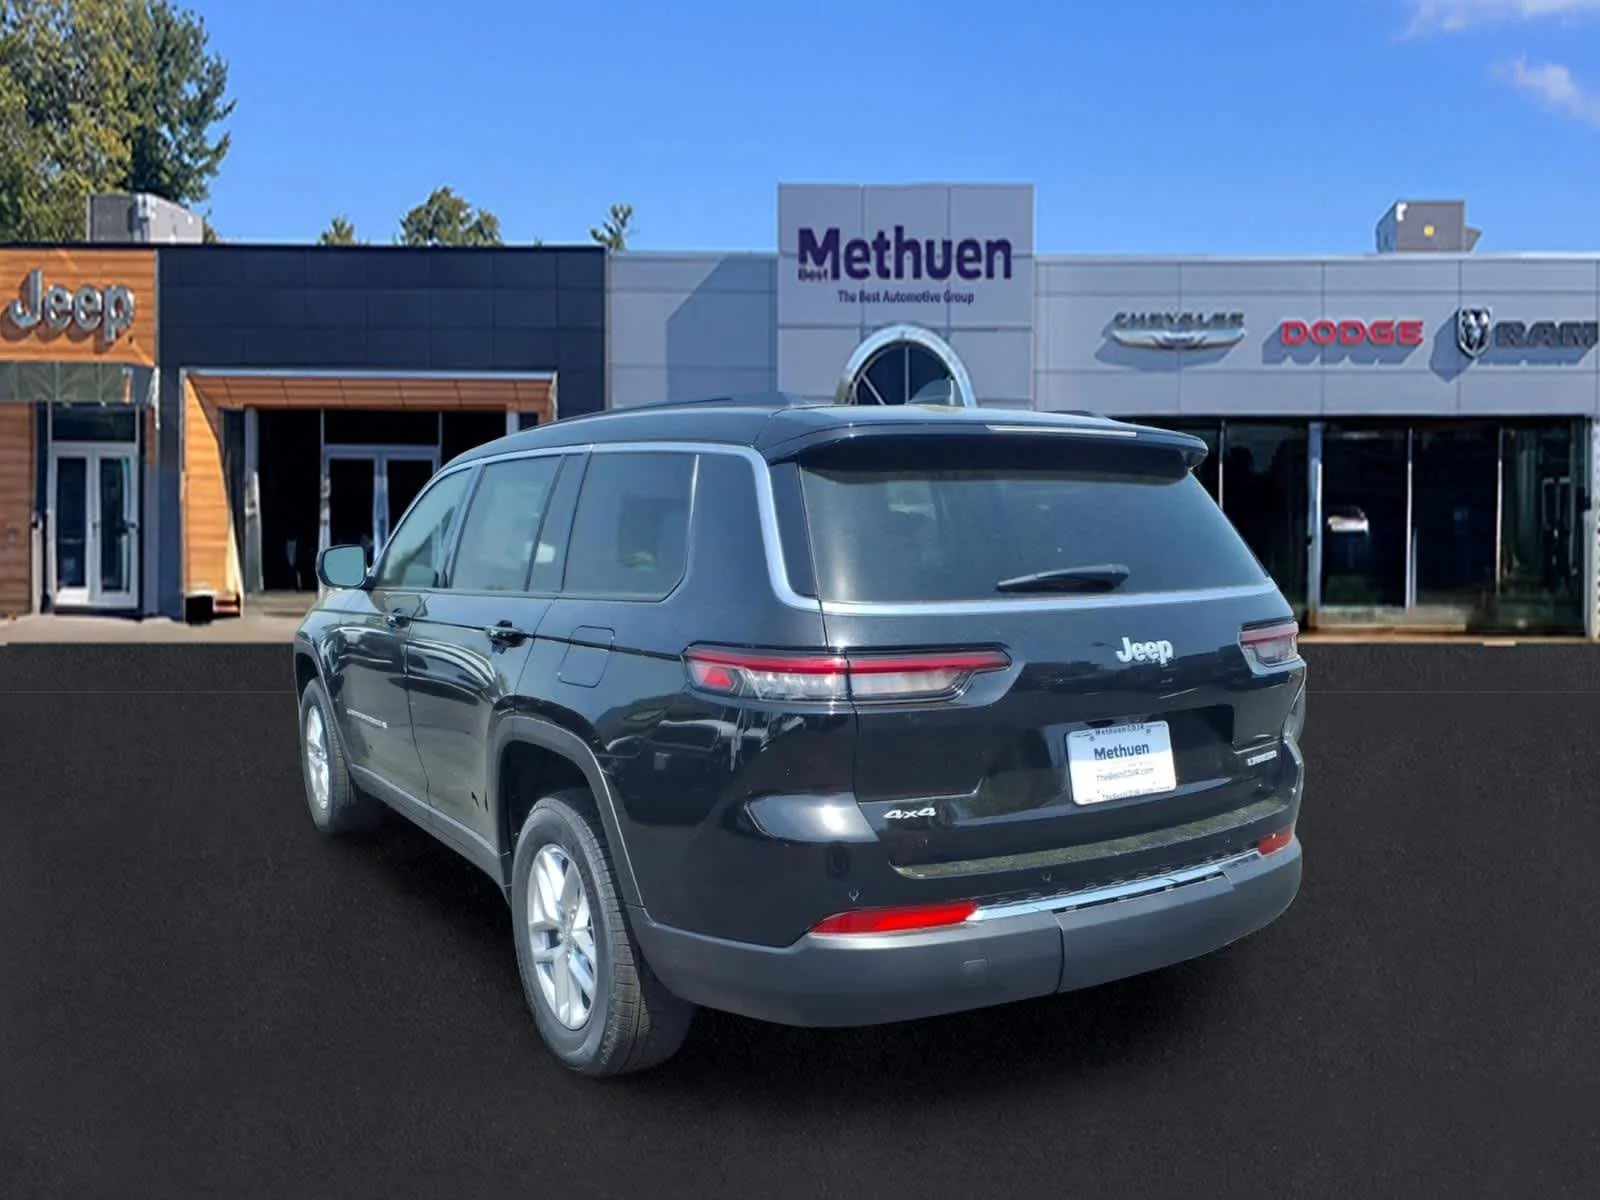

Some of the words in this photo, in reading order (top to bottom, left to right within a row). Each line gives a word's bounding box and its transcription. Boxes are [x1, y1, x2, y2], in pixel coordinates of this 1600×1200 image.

[798, 225, 1012, 280] Methuen
[8, 269, 135, 342] Jeep
[837, 290, 856, 303] The
[859, 290, 880, 303] Best
[882, 290, 941, 303] Automotive
[943, 290, 975, 305] Group
[1114, 312, 1245, 331] CHRYSLER
[1281, 319, 1424, 346] DODGE
[1494, 321, 1599, 348] RAM
[1116, 636, 1174, 667] Jeep
[1093, 743, 1150, 761] Methuen
[883, 807, 936, 819] 4x4
